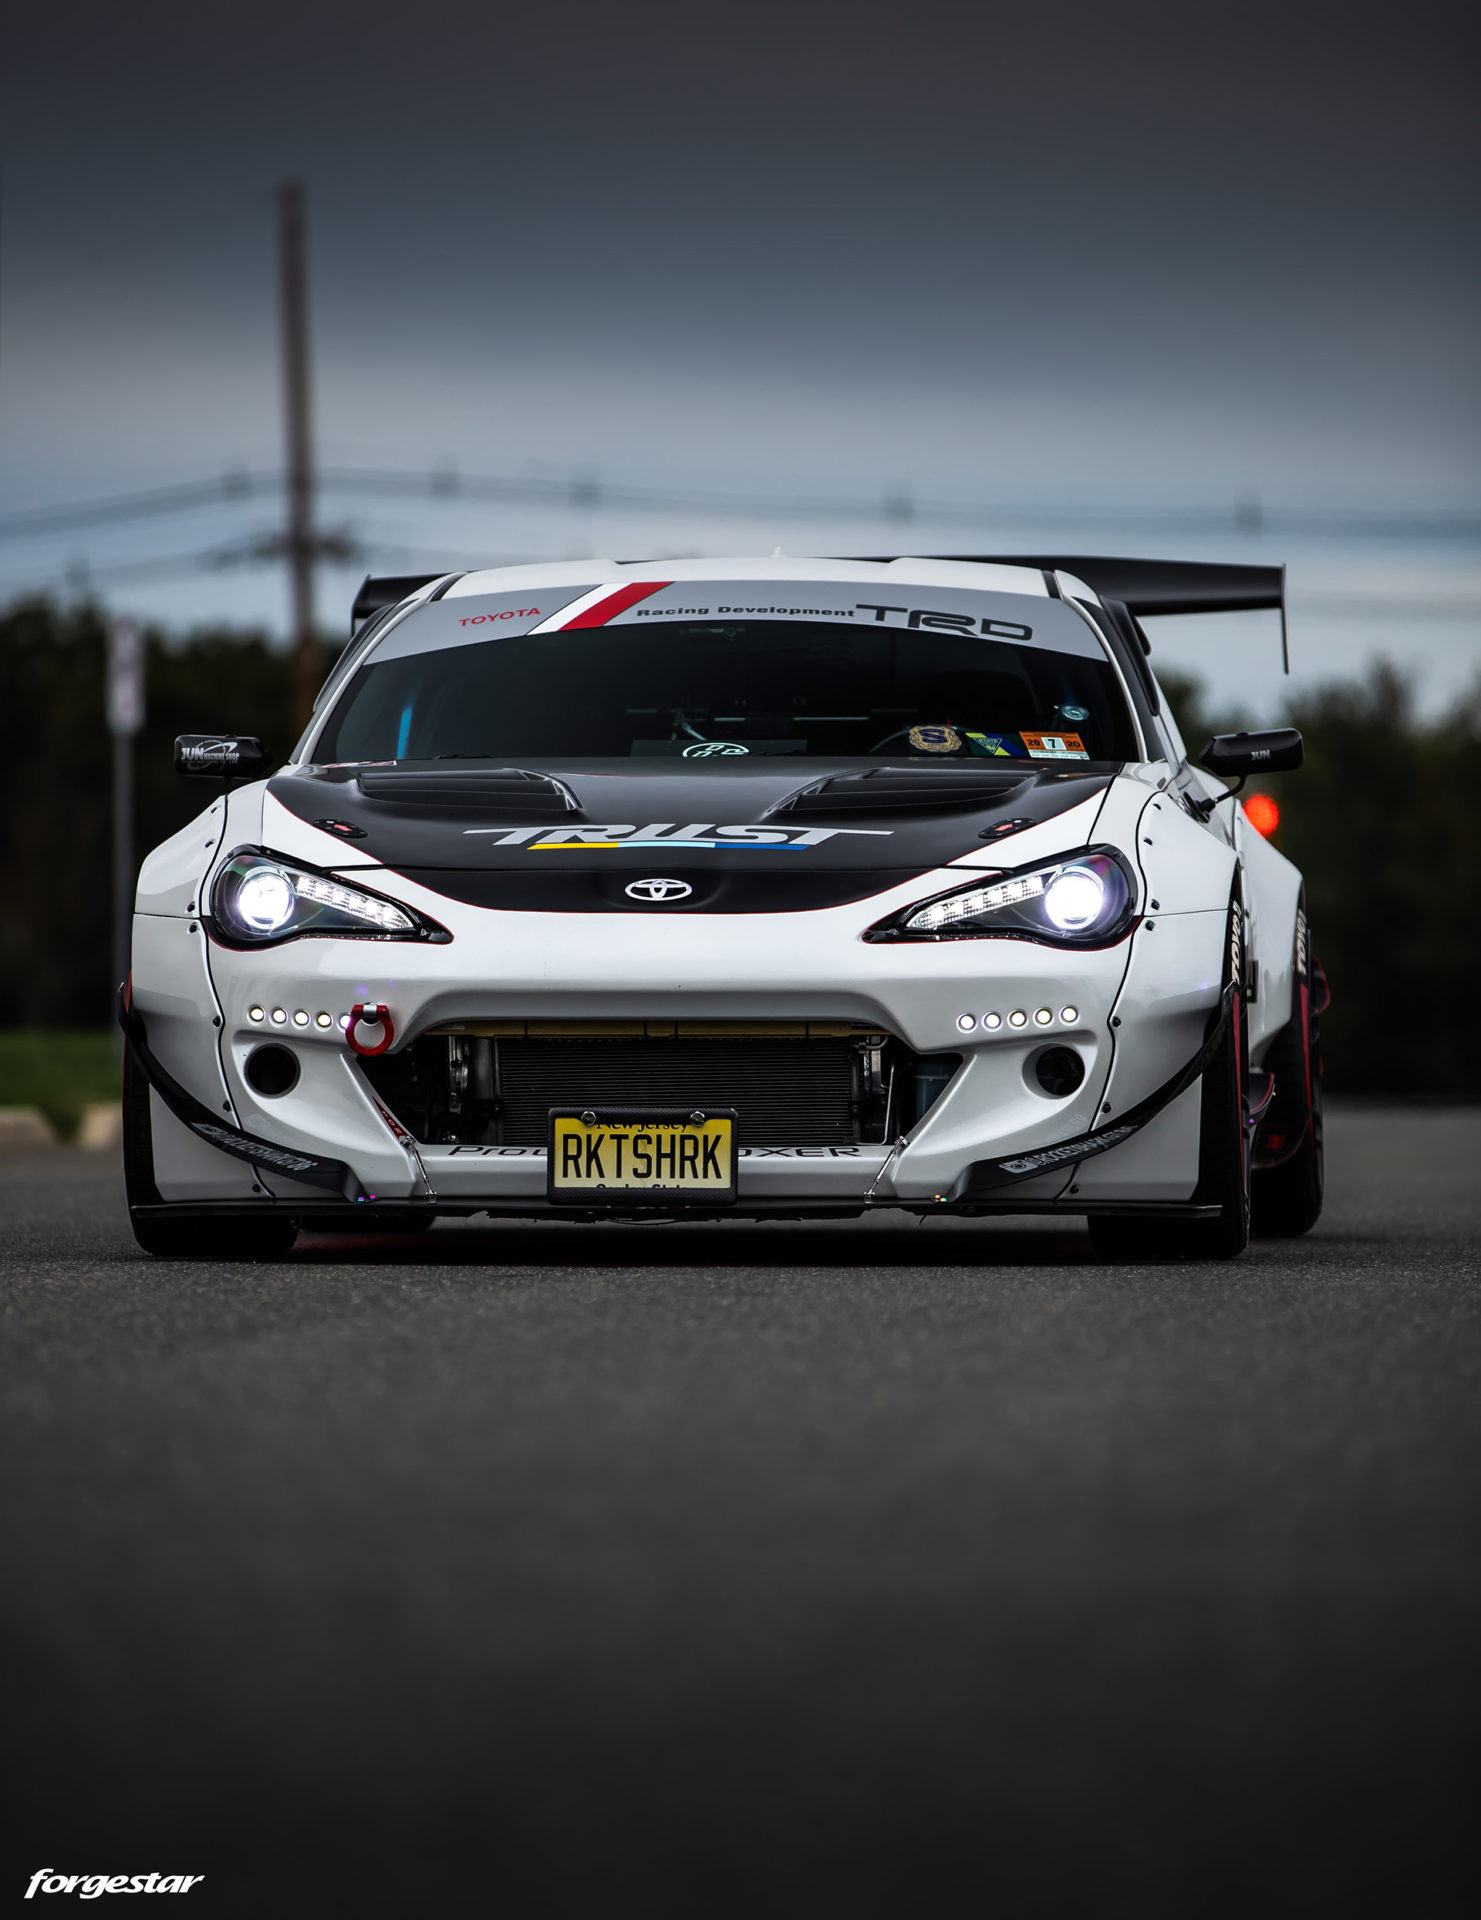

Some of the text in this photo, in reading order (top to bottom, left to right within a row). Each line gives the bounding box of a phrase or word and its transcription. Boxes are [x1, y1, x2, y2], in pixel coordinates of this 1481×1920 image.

[458, 607, 540, 626] TOYOTA
[637, 606, 855, 617] Racing Development
[856, 604, 1032, 640] TRD
[1047, 738, 1056, 748] 7
[181, 747, 205, 760] JUN
[1250, 749, 1272, 760] JUN
[462, 823, 893, 845] TRUST
[562, 1134, 722, 1179] RKTSHRK
